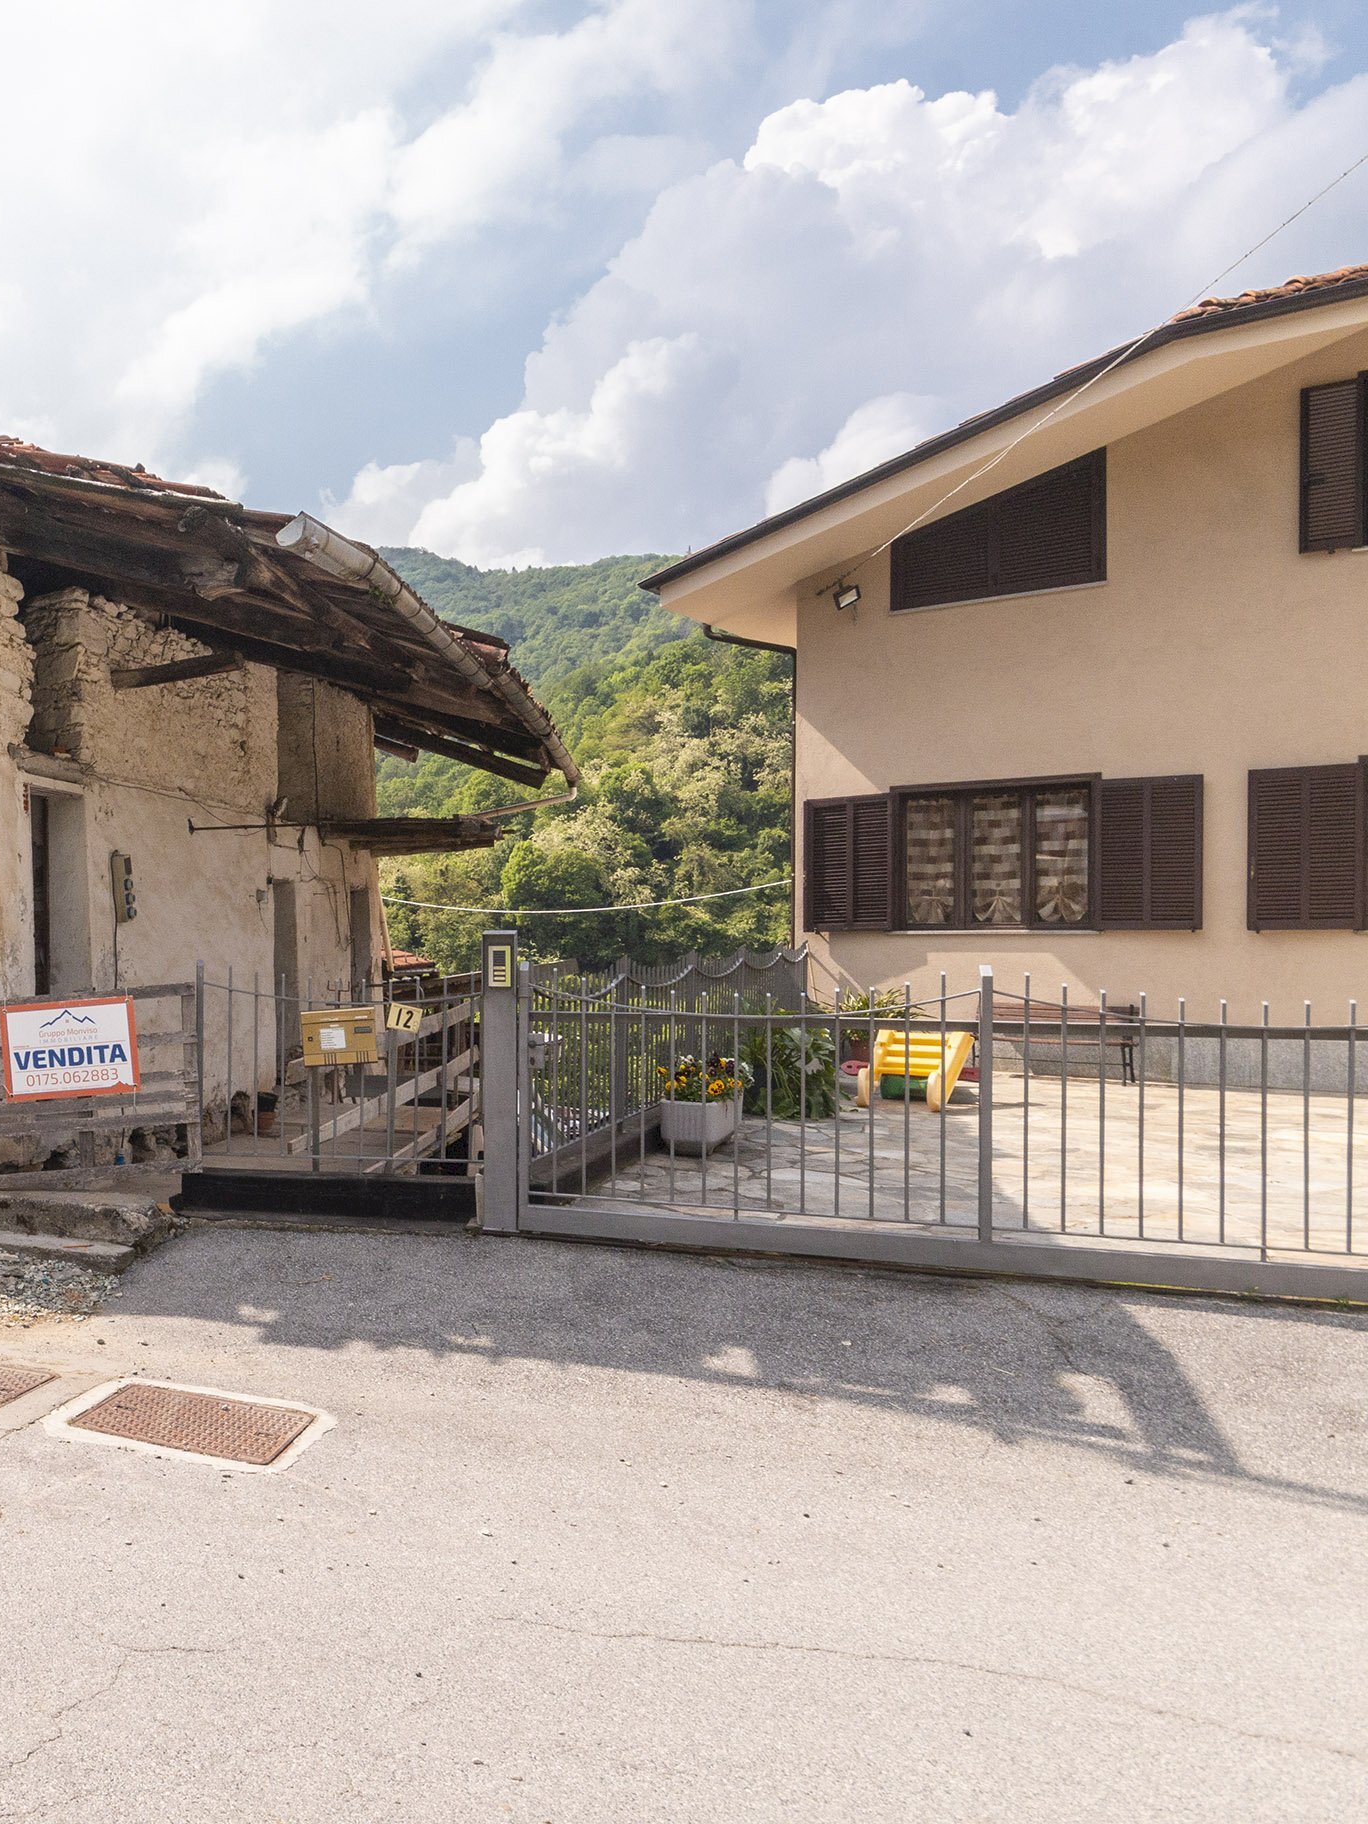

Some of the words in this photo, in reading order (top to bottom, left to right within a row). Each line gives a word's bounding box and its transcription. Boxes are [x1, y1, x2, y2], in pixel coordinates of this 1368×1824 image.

[395, 1008, 414, 1028] 12
[38, 1030, 66, 1038] Gruppo
[66, 1028, 98, 1036] Monviso
[39, 1035, 98, 1044] IMMOBILIARE
[13, 1043, 128, 1071] VENDITA
[26, 1068, 119, 1087] 0175.062883
